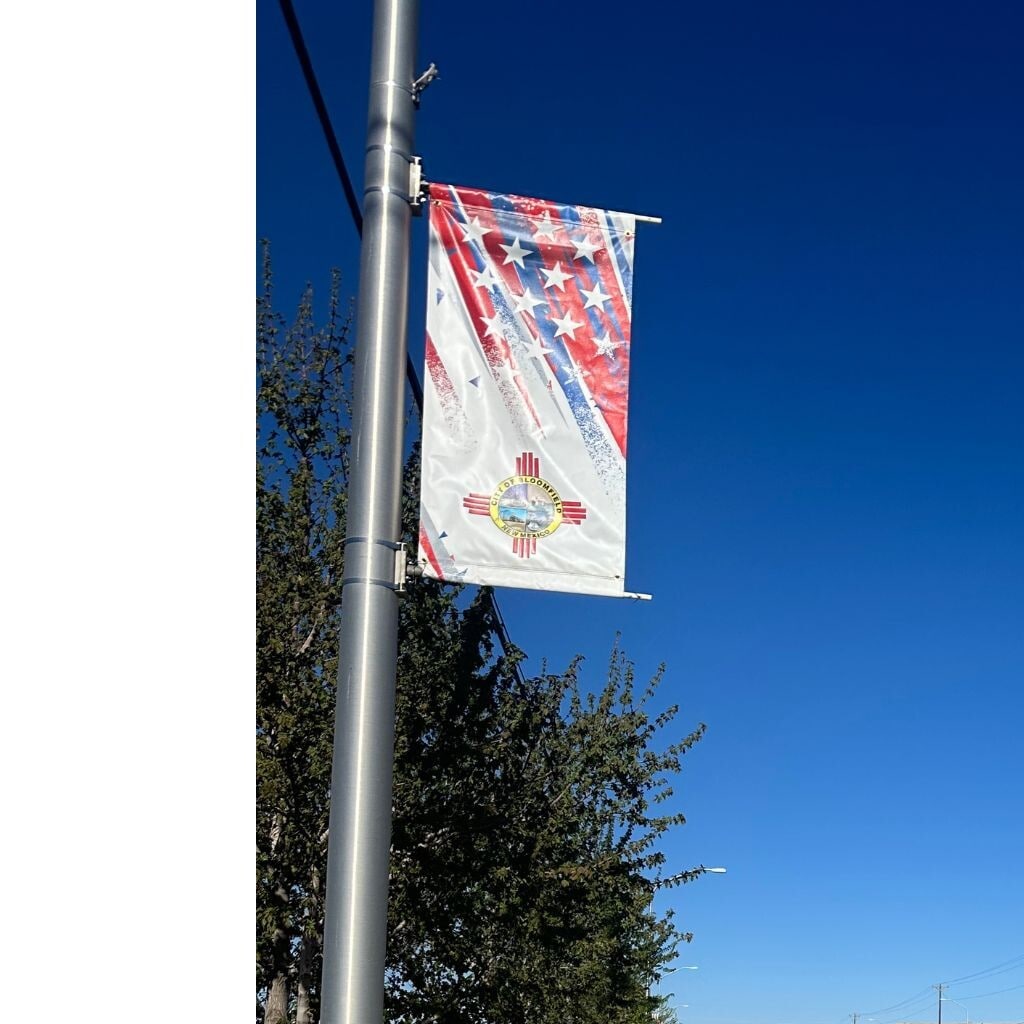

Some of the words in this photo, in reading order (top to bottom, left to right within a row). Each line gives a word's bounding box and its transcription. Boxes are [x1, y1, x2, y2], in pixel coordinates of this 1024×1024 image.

[491, 487, 503, 506] CITY
[504, 478, 514, 487] OF
[502, 525, 519, 536] NEW
[520, 529, 549, 538] MEXICO
